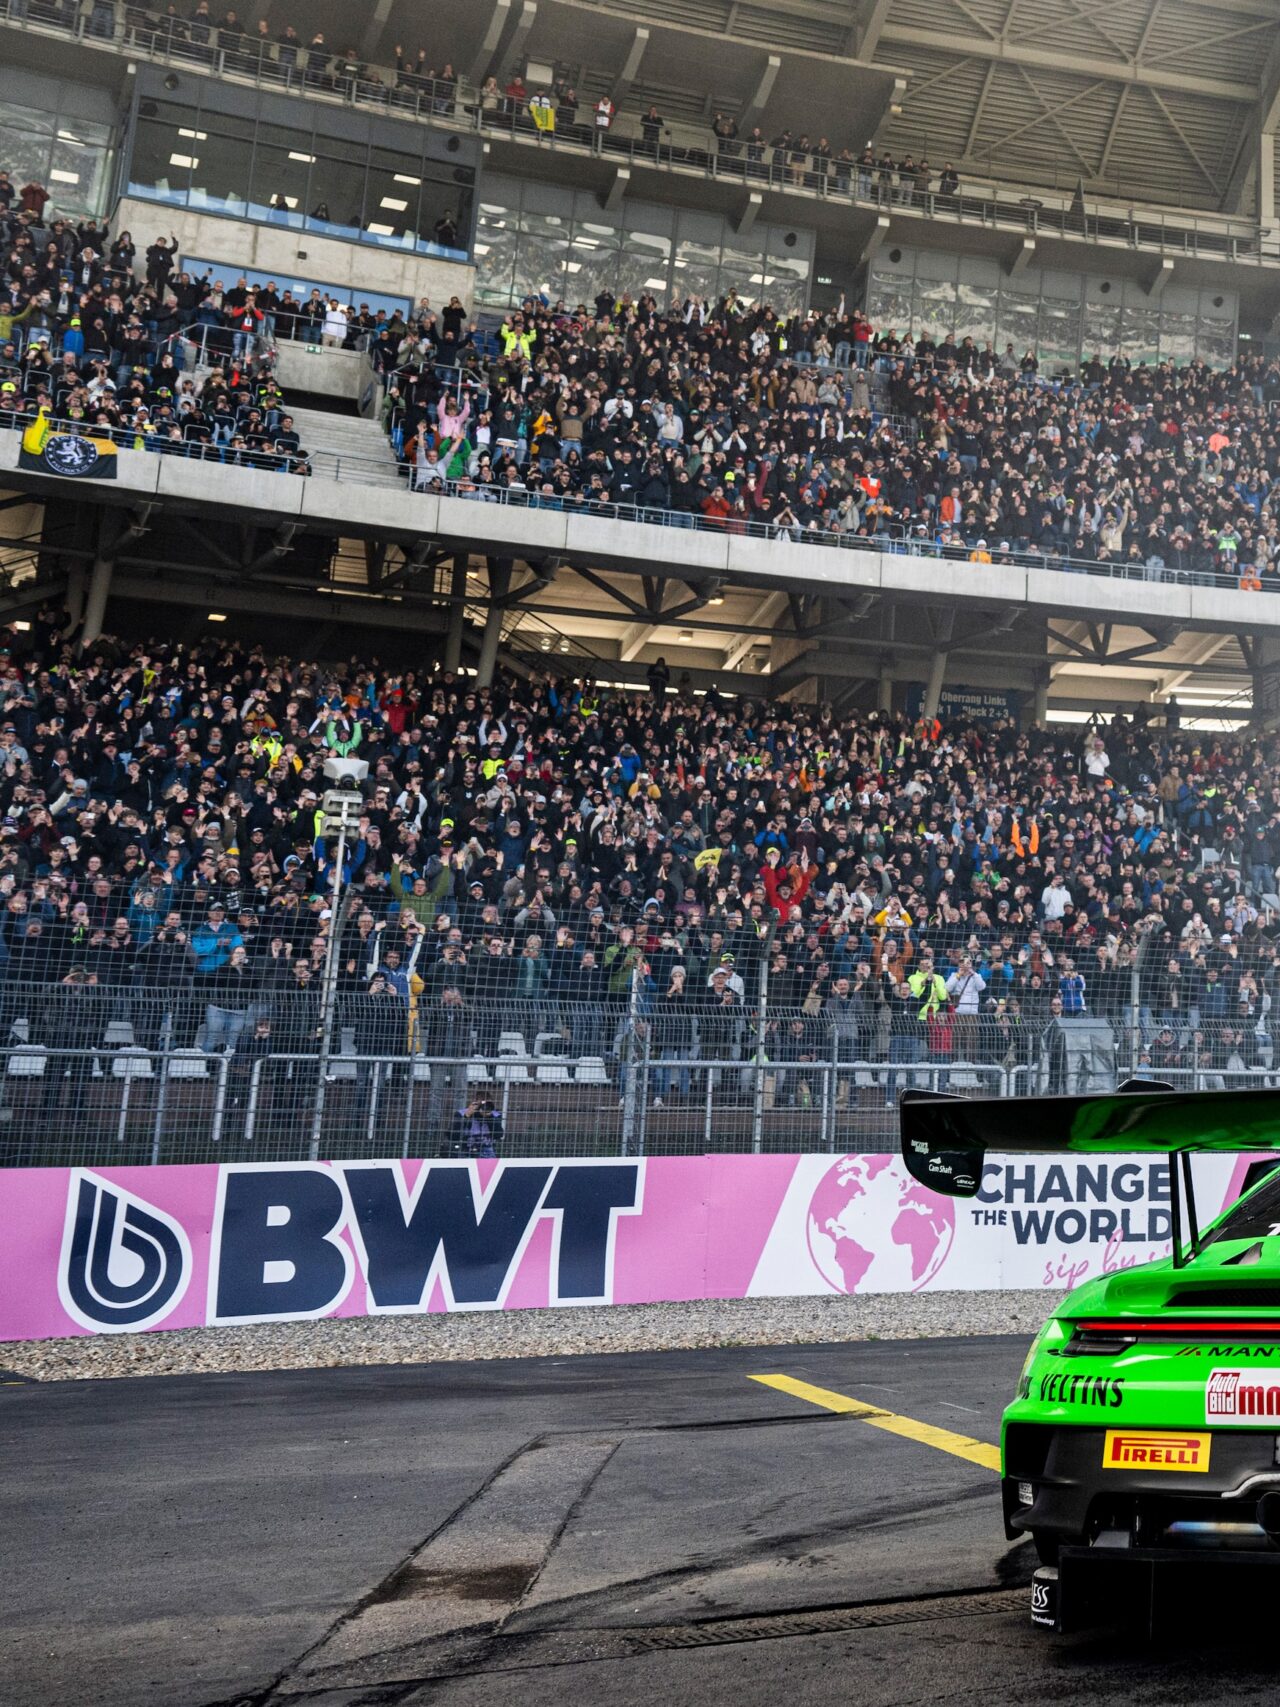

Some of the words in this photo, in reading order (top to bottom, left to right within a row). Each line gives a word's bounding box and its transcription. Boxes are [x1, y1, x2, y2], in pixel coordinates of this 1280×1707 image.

[984, 696, 1007, 706] Links
[975, 1163, 1171, 1203] CHANGE
[215, 1165, 638, 1318] BWT
[971, 1210, 1007, 1226] THE
[1011, 1208, 1174, 1245] WORLD
[1043, 1253, 1089, 1290] sip
[1040, 1373, 1125, 1408] VELTINS
[1210, 1373, 1238, 1392] Auto
[1209, 1393, 1236, 1413] Bild
[1112, 1437, 1200, 1465] PIRELLI
